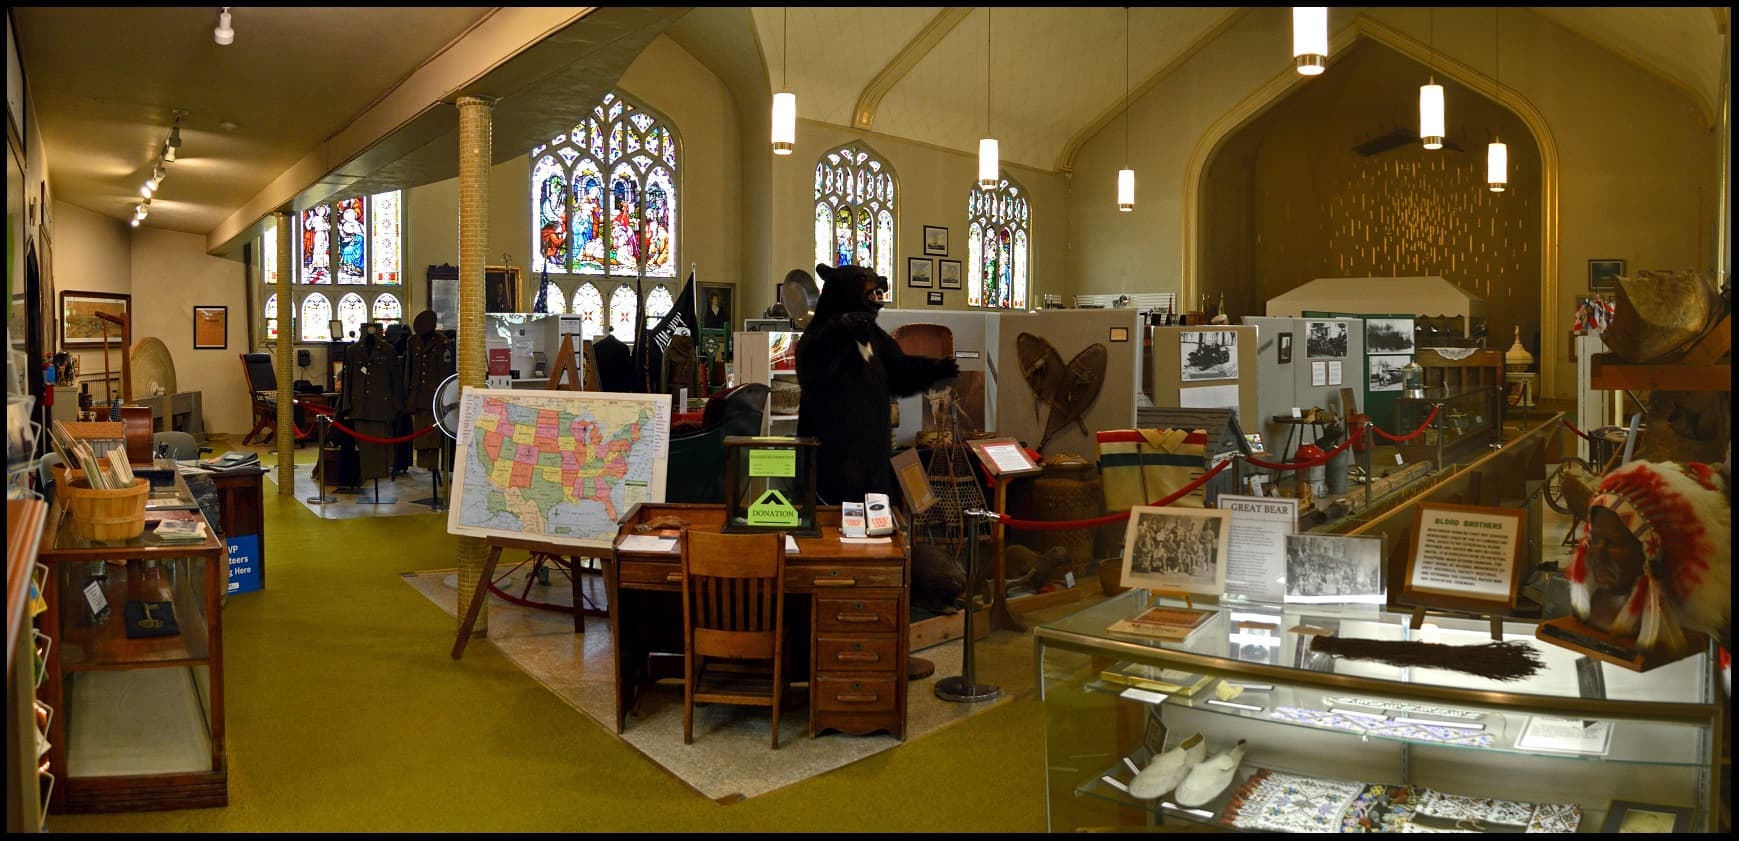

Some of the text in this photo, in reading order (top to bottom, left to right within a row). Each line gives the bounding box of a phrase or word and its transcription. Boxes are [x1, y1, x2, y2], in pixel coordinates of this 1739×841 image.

[1231, 503, 1289, 514] GREAT BEAR
[752, 510, 794, 518] DONATION
[1435, 518, 1503, 529] BLOOD BROTHERS
[228, 545, 239, 554] VP
[228, 557, 248, 565] teers
[235, 567, 251, 575] Here
